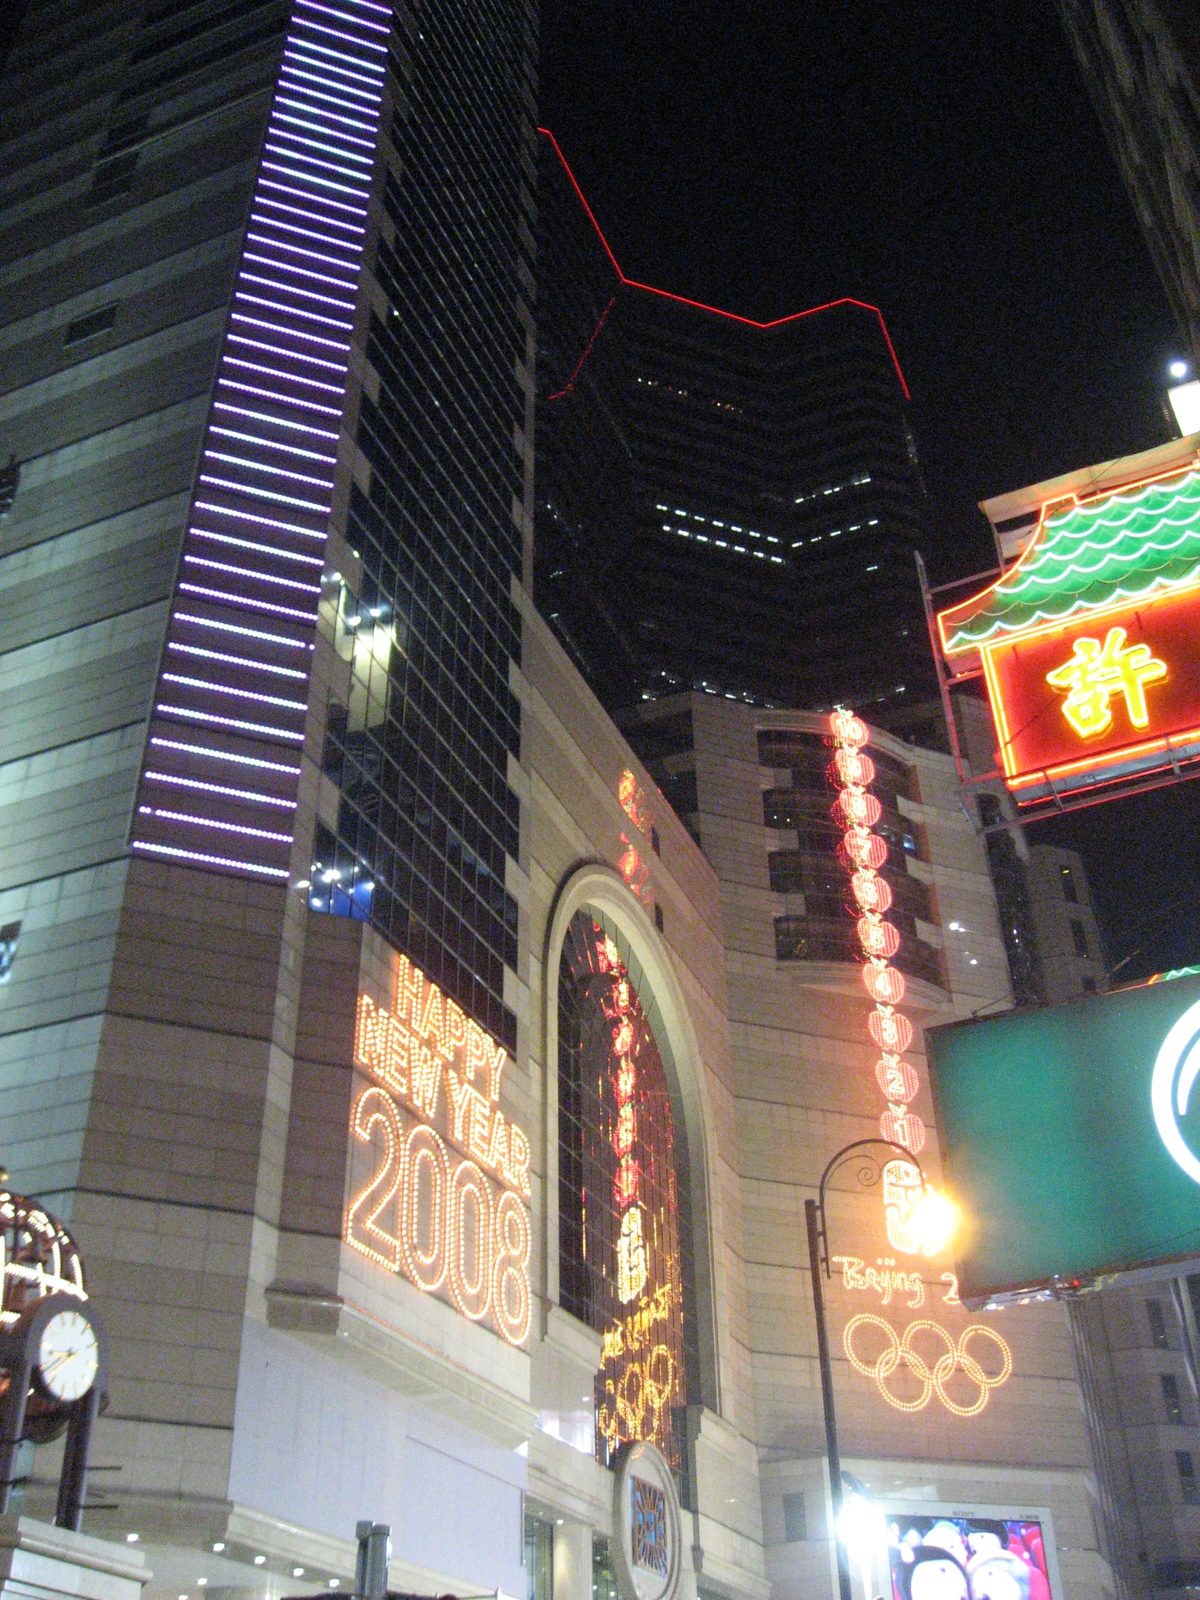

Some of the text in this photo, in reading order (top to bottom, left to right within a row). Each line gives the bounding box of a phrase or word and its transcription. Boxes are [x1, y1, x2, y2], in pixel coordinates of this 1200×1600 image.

[1046, 627, 1168, 739] 許
[836, 718, 862, 739] 10
[857, 838, 872, 860] 7
[876, 972, 892, 996] 4
[396, 953, 508, 1102] HAPPY
[882, 1018, 898, 1044] 3
[886, 1069, 905, 1094] 2
[356, 994, 531, 1197] NEW YEAR
[893, 1119, 909, 1146] 1
[345, 1086, 532, 1346] 2008
[831, 1255, 925, 1308] Beijing
